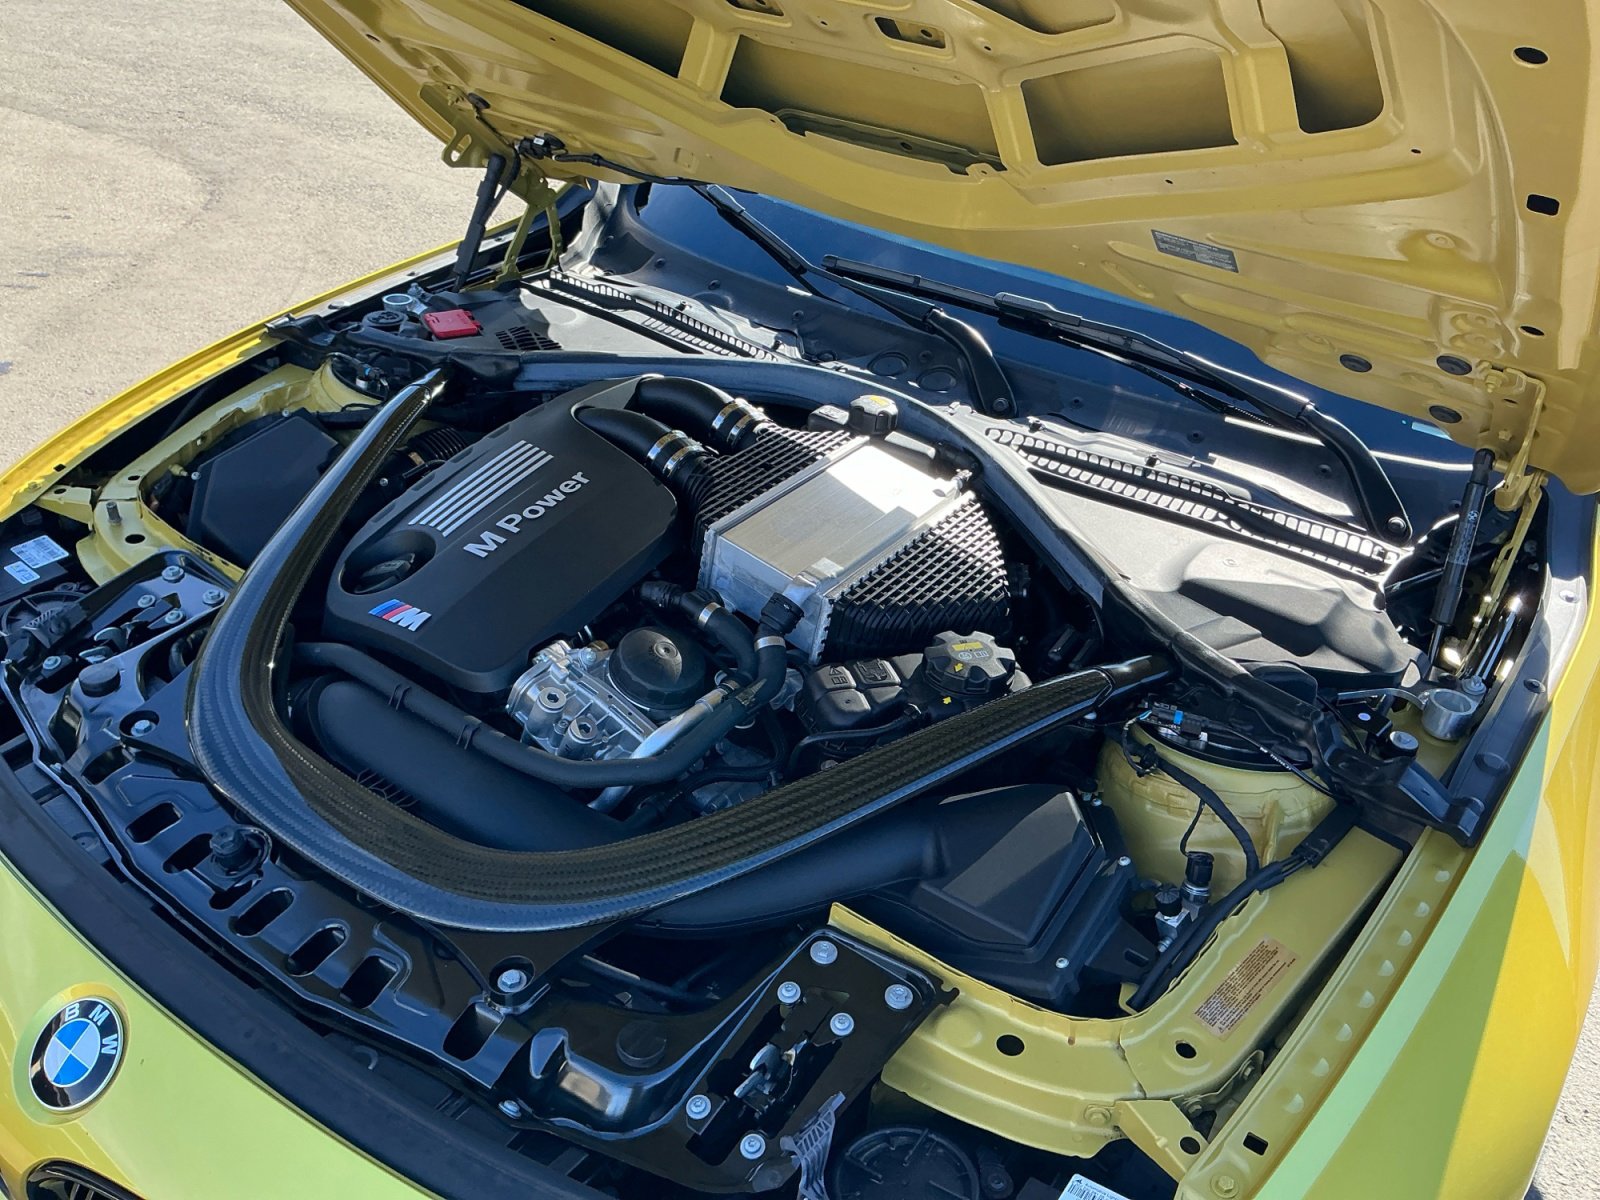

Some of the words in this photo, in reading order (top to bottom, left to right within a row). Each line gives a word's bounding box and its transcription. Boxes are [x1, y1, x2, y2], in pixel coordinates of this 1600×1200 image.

[463, 530, 507, 558] M
[495, 471, 590, 534] Power
[388, 607, 432, 632] M
[64, 1002, 118, 1055] BMW
